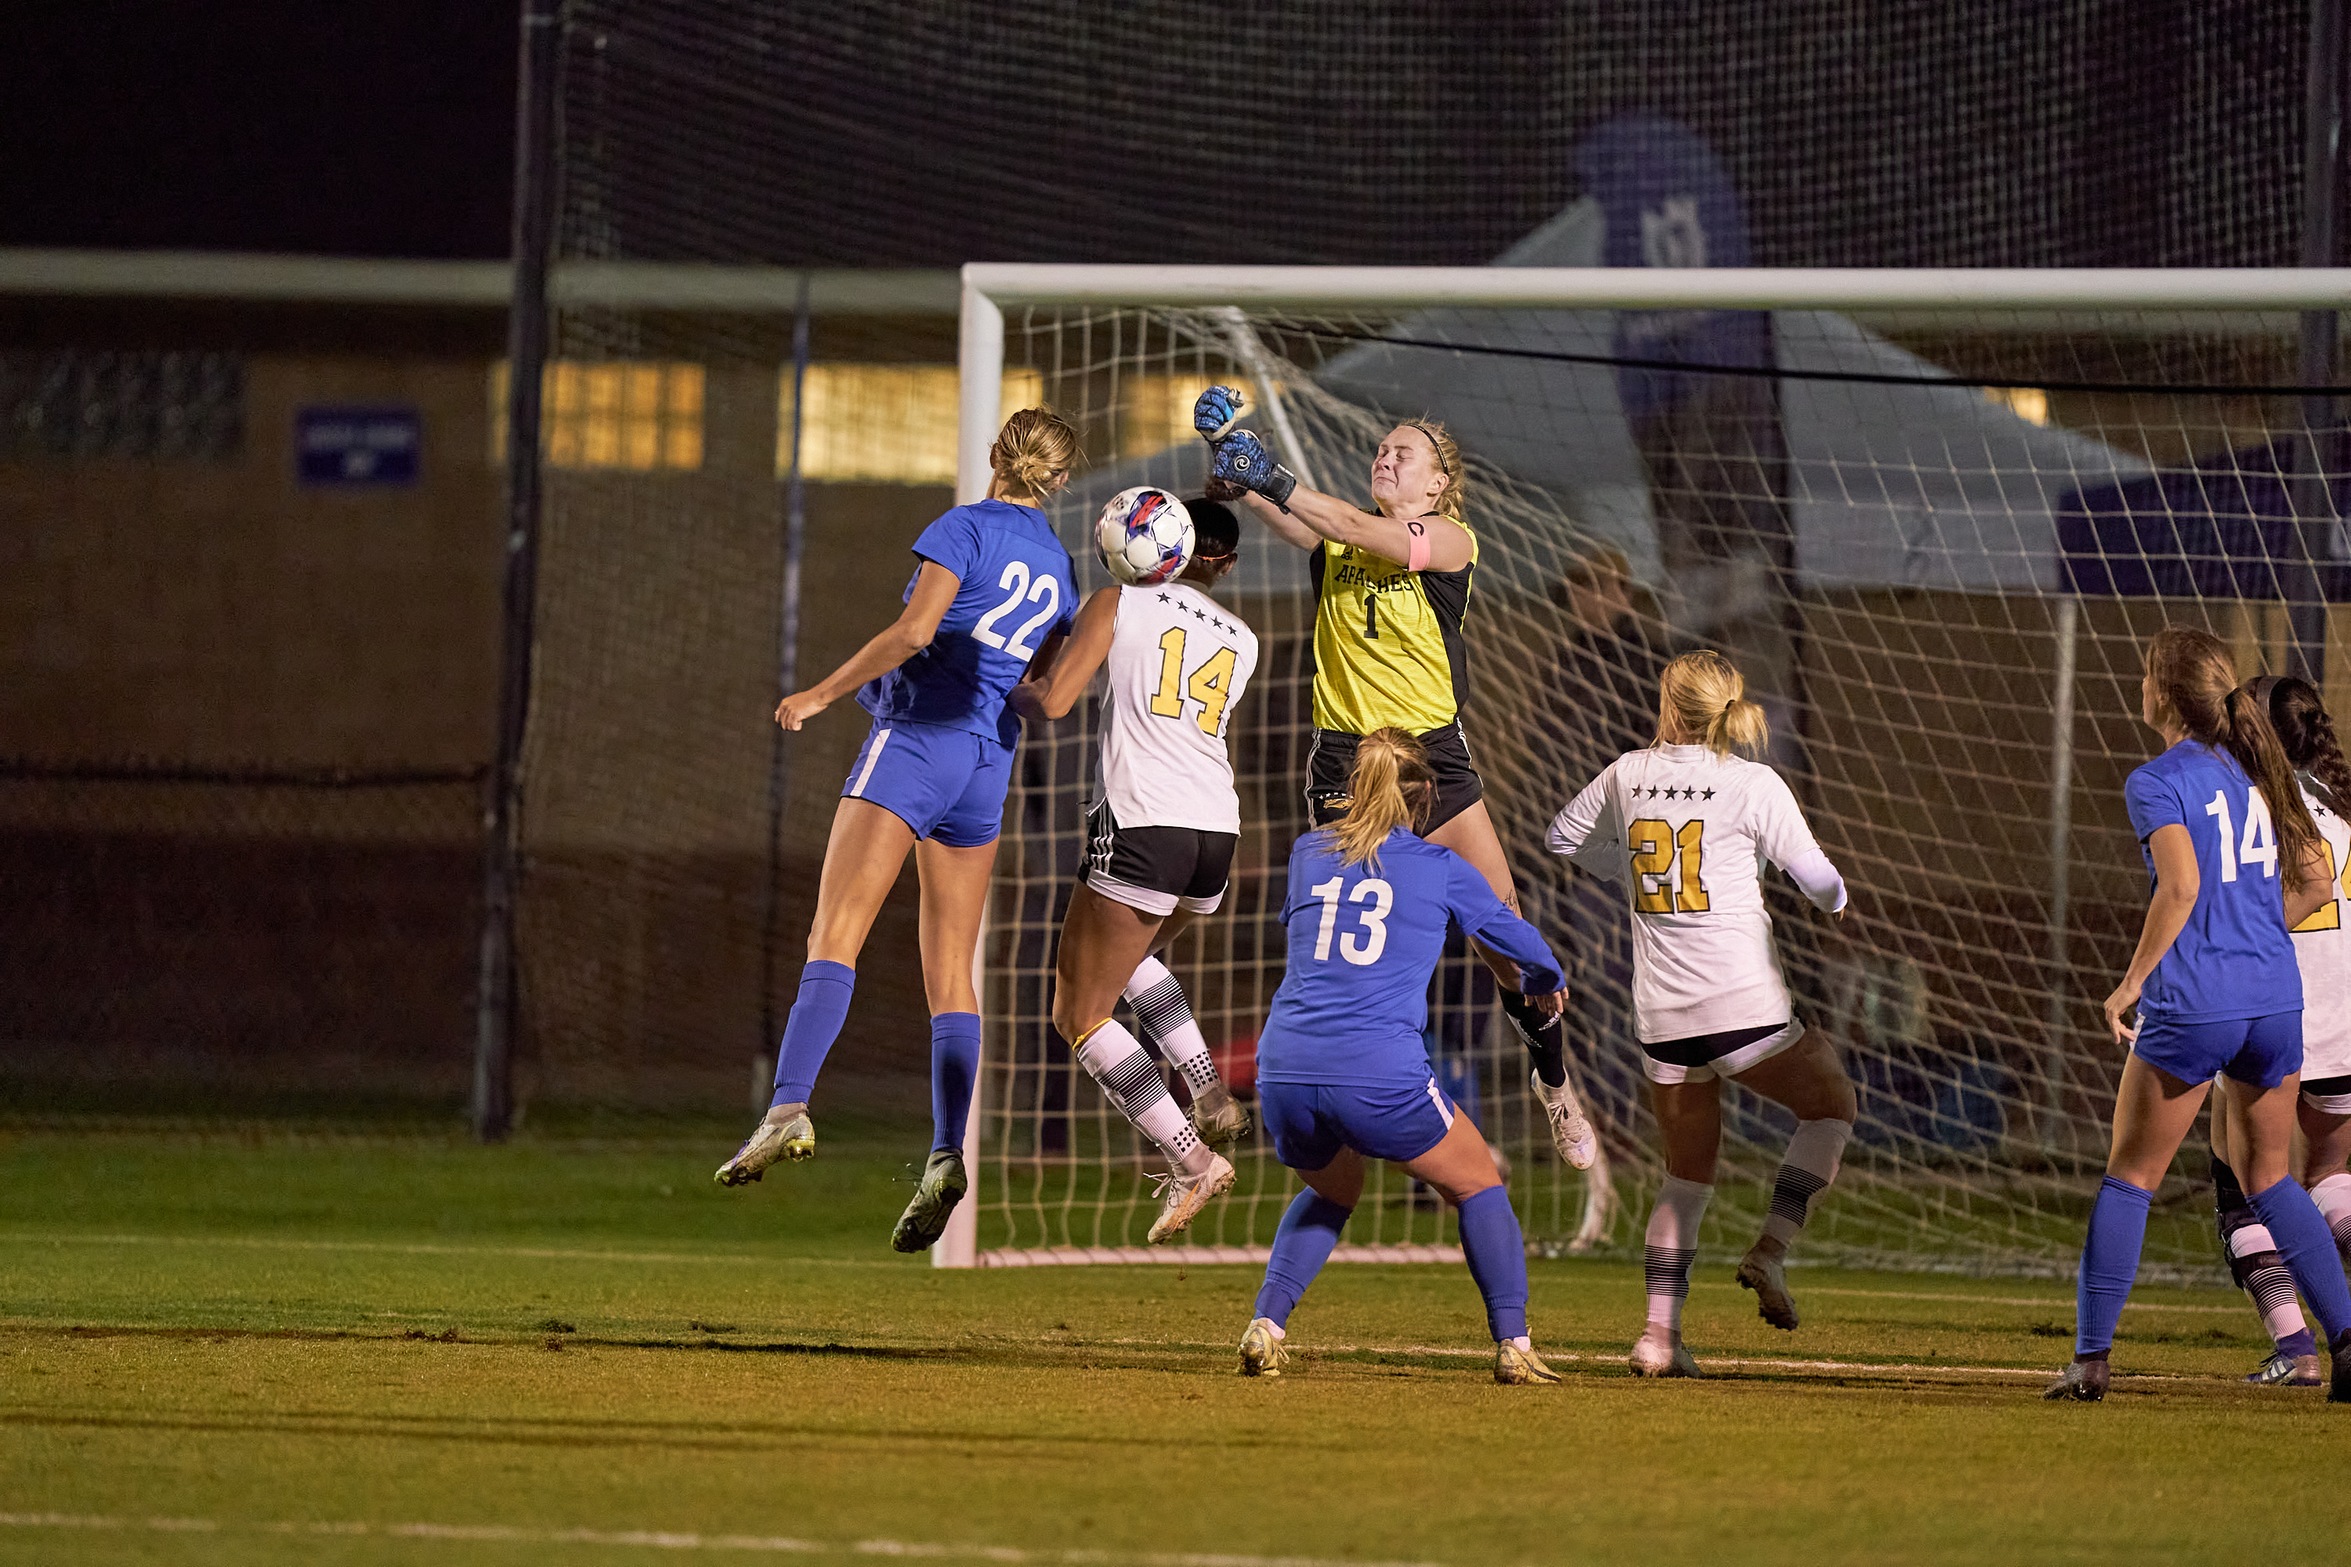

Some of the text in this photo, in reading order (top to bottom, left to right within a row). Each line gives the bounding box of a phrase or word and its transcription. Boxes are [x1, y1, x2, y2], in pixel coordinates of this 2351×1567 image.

[971, 561, 1060, 662] 22
[1364, 594, 1379, 639] 1
[1150, 626, 1237, 738] 14
[1628, 818, 1711, 914] 21
[2205, 786, 2278, 883] 14
[1311, 876, 1394, 966] 13
